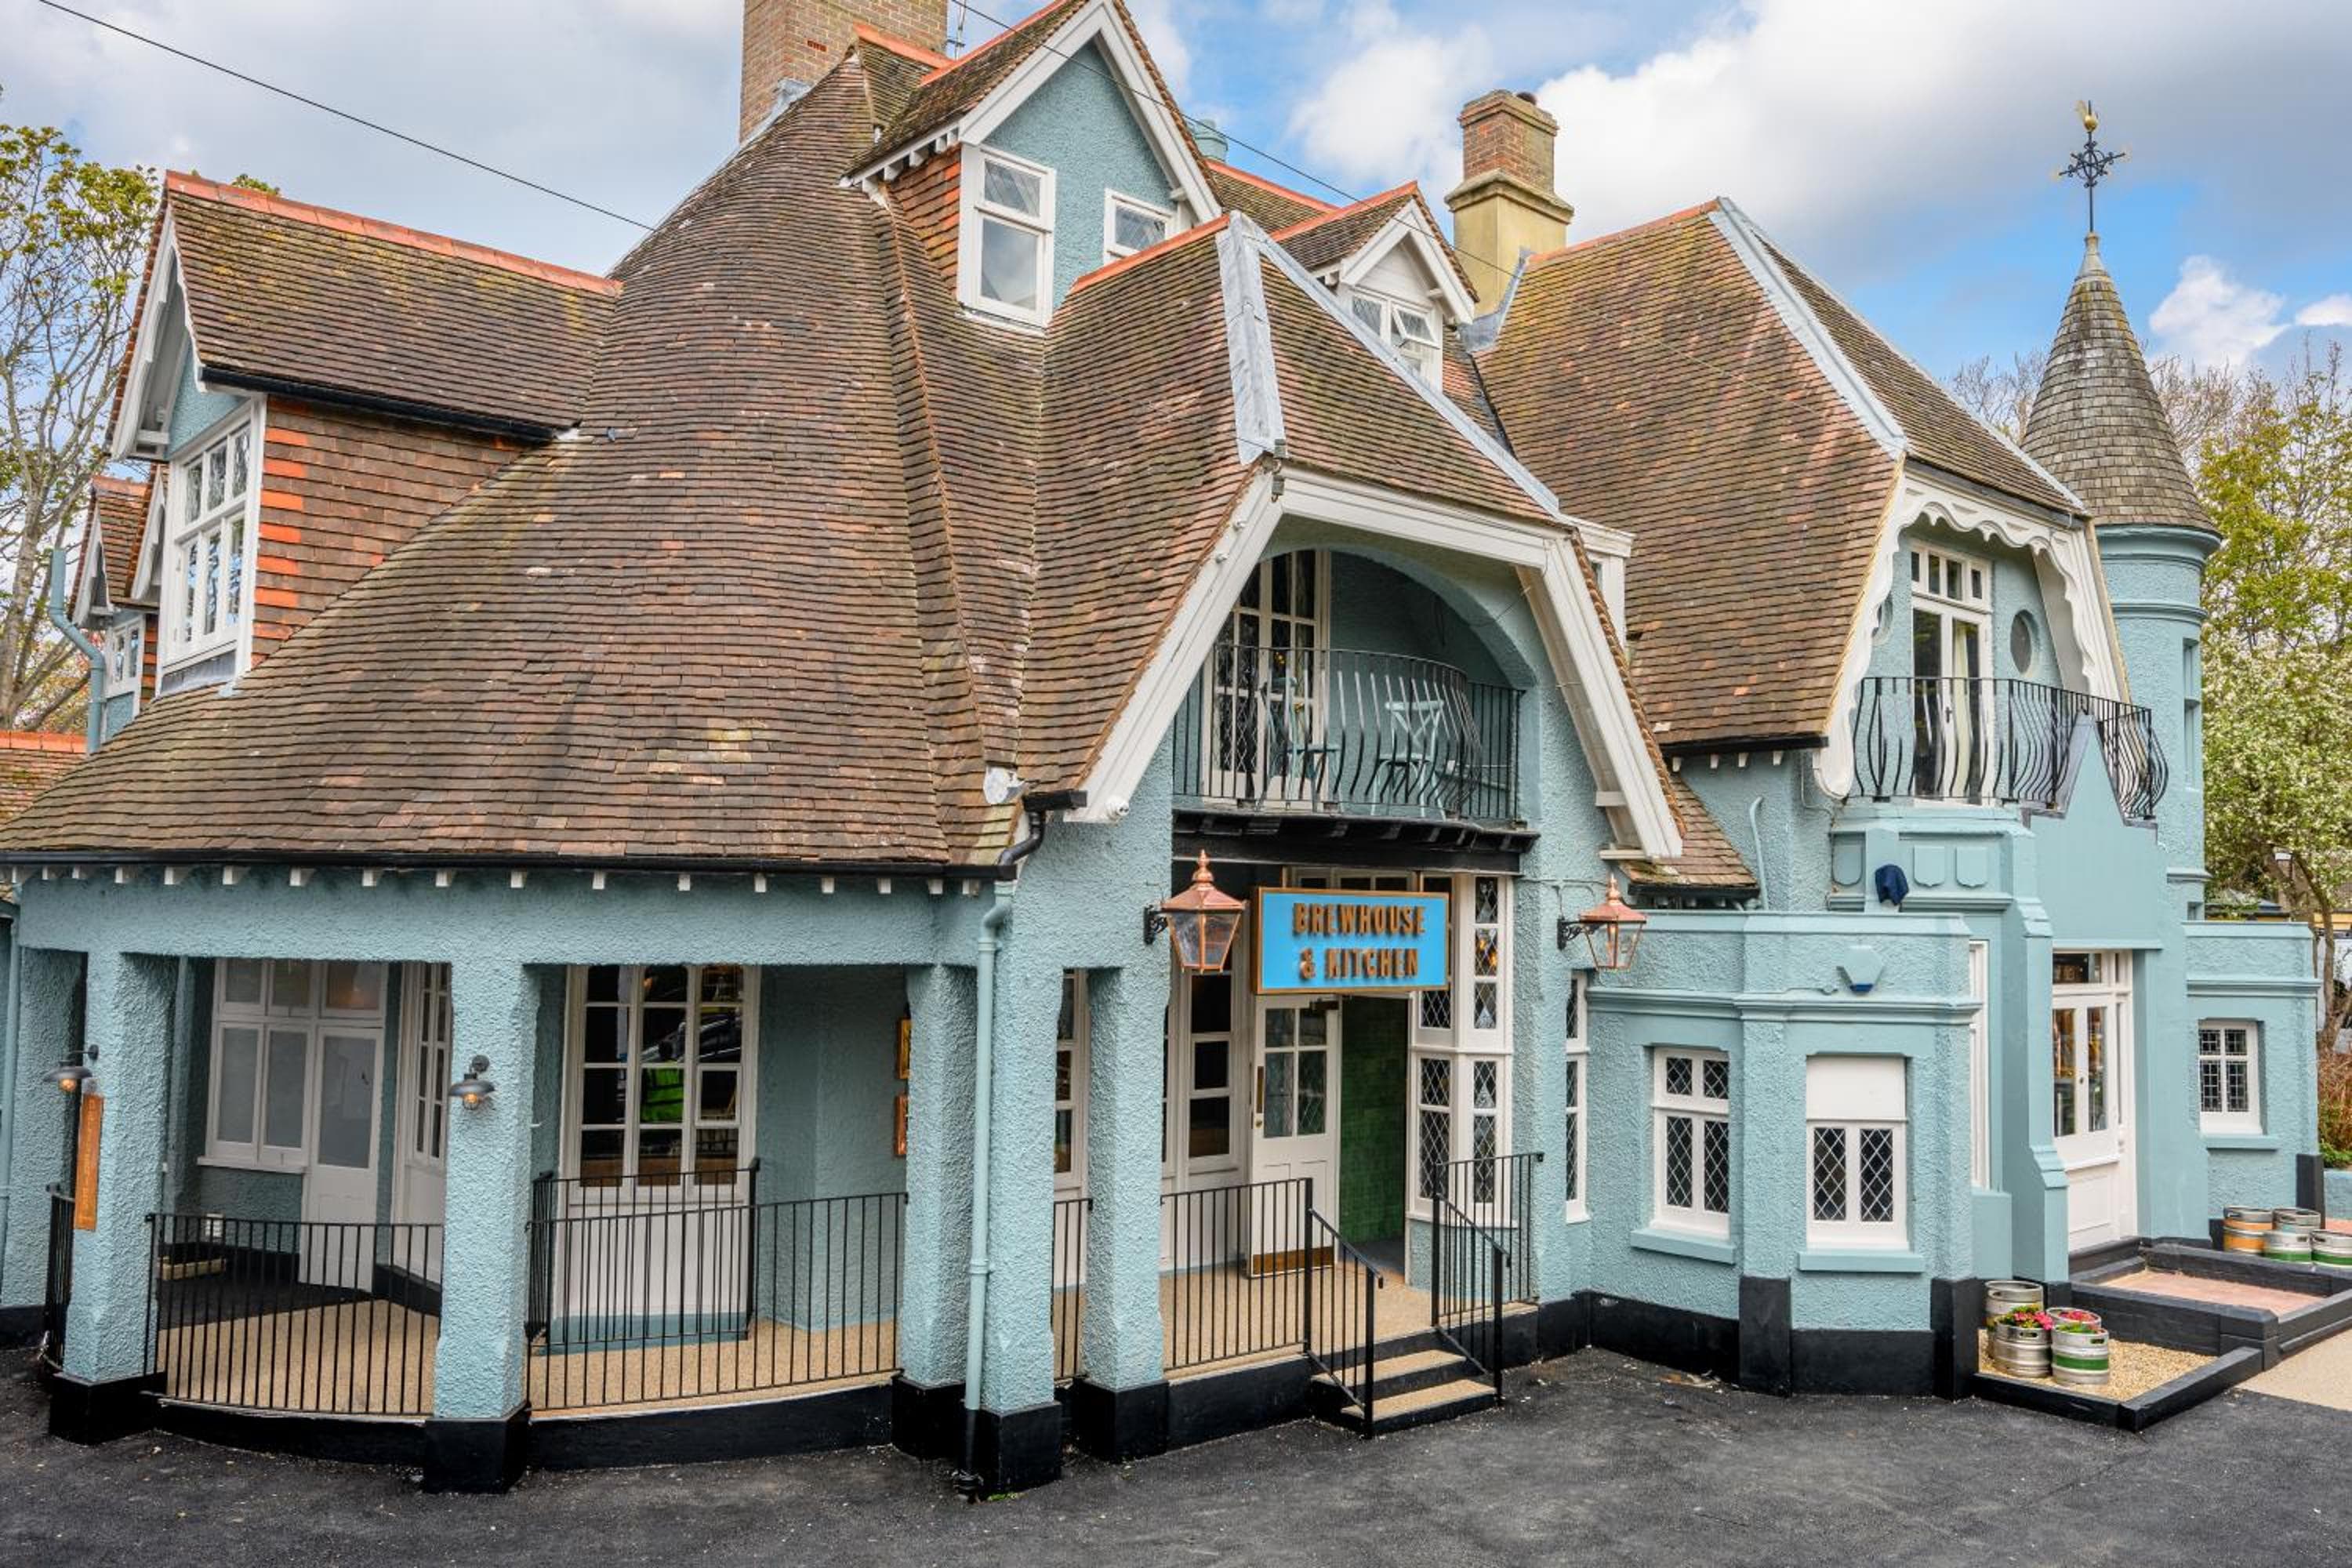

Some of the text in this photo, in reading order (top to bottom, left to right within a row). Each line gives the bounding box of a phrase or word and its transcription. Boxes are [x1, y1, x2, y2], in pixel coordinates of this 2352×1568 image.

[1294, 903, 1425, 935] BREWHOUSE
[1301, 948, 1418, 978] & KITCHEN
